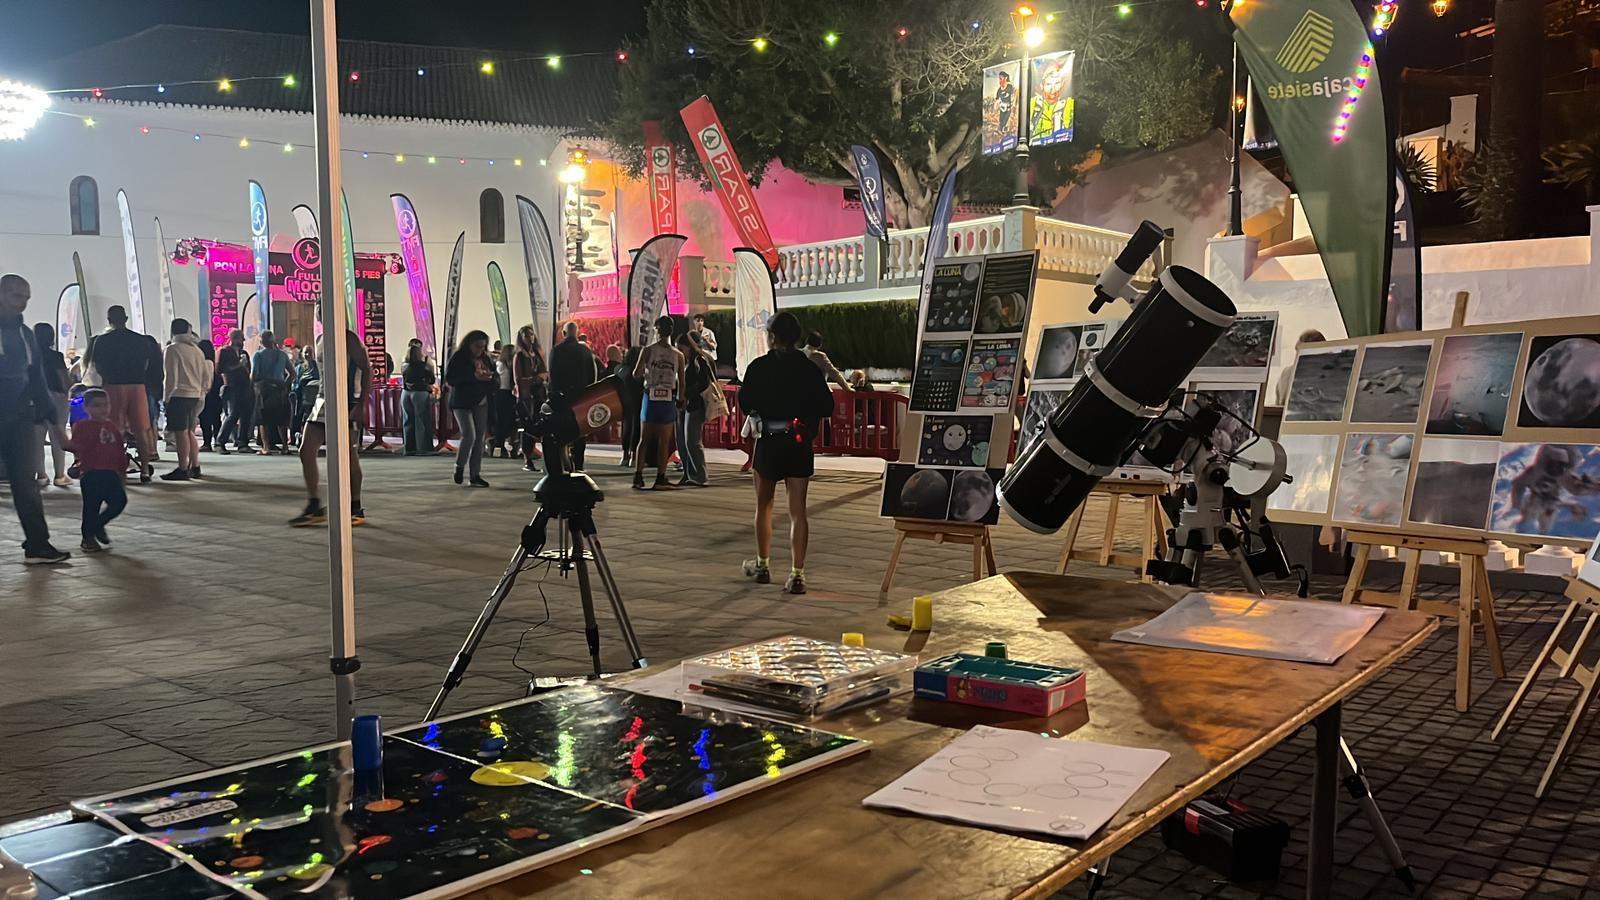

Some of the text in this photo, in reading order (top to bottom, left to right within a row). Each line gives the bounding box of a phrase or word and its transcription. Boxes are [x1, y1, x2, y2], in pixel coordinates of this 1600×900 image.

[214, 262, 237, 273] PON
[362, 270, 381, 279] PIES
[298, 273, 321, 281] FULL
[288, 280, 321, 295] MOO
[641, 258, 660, 314] TRAIL
[296, 292, 320, 300] TRAI
